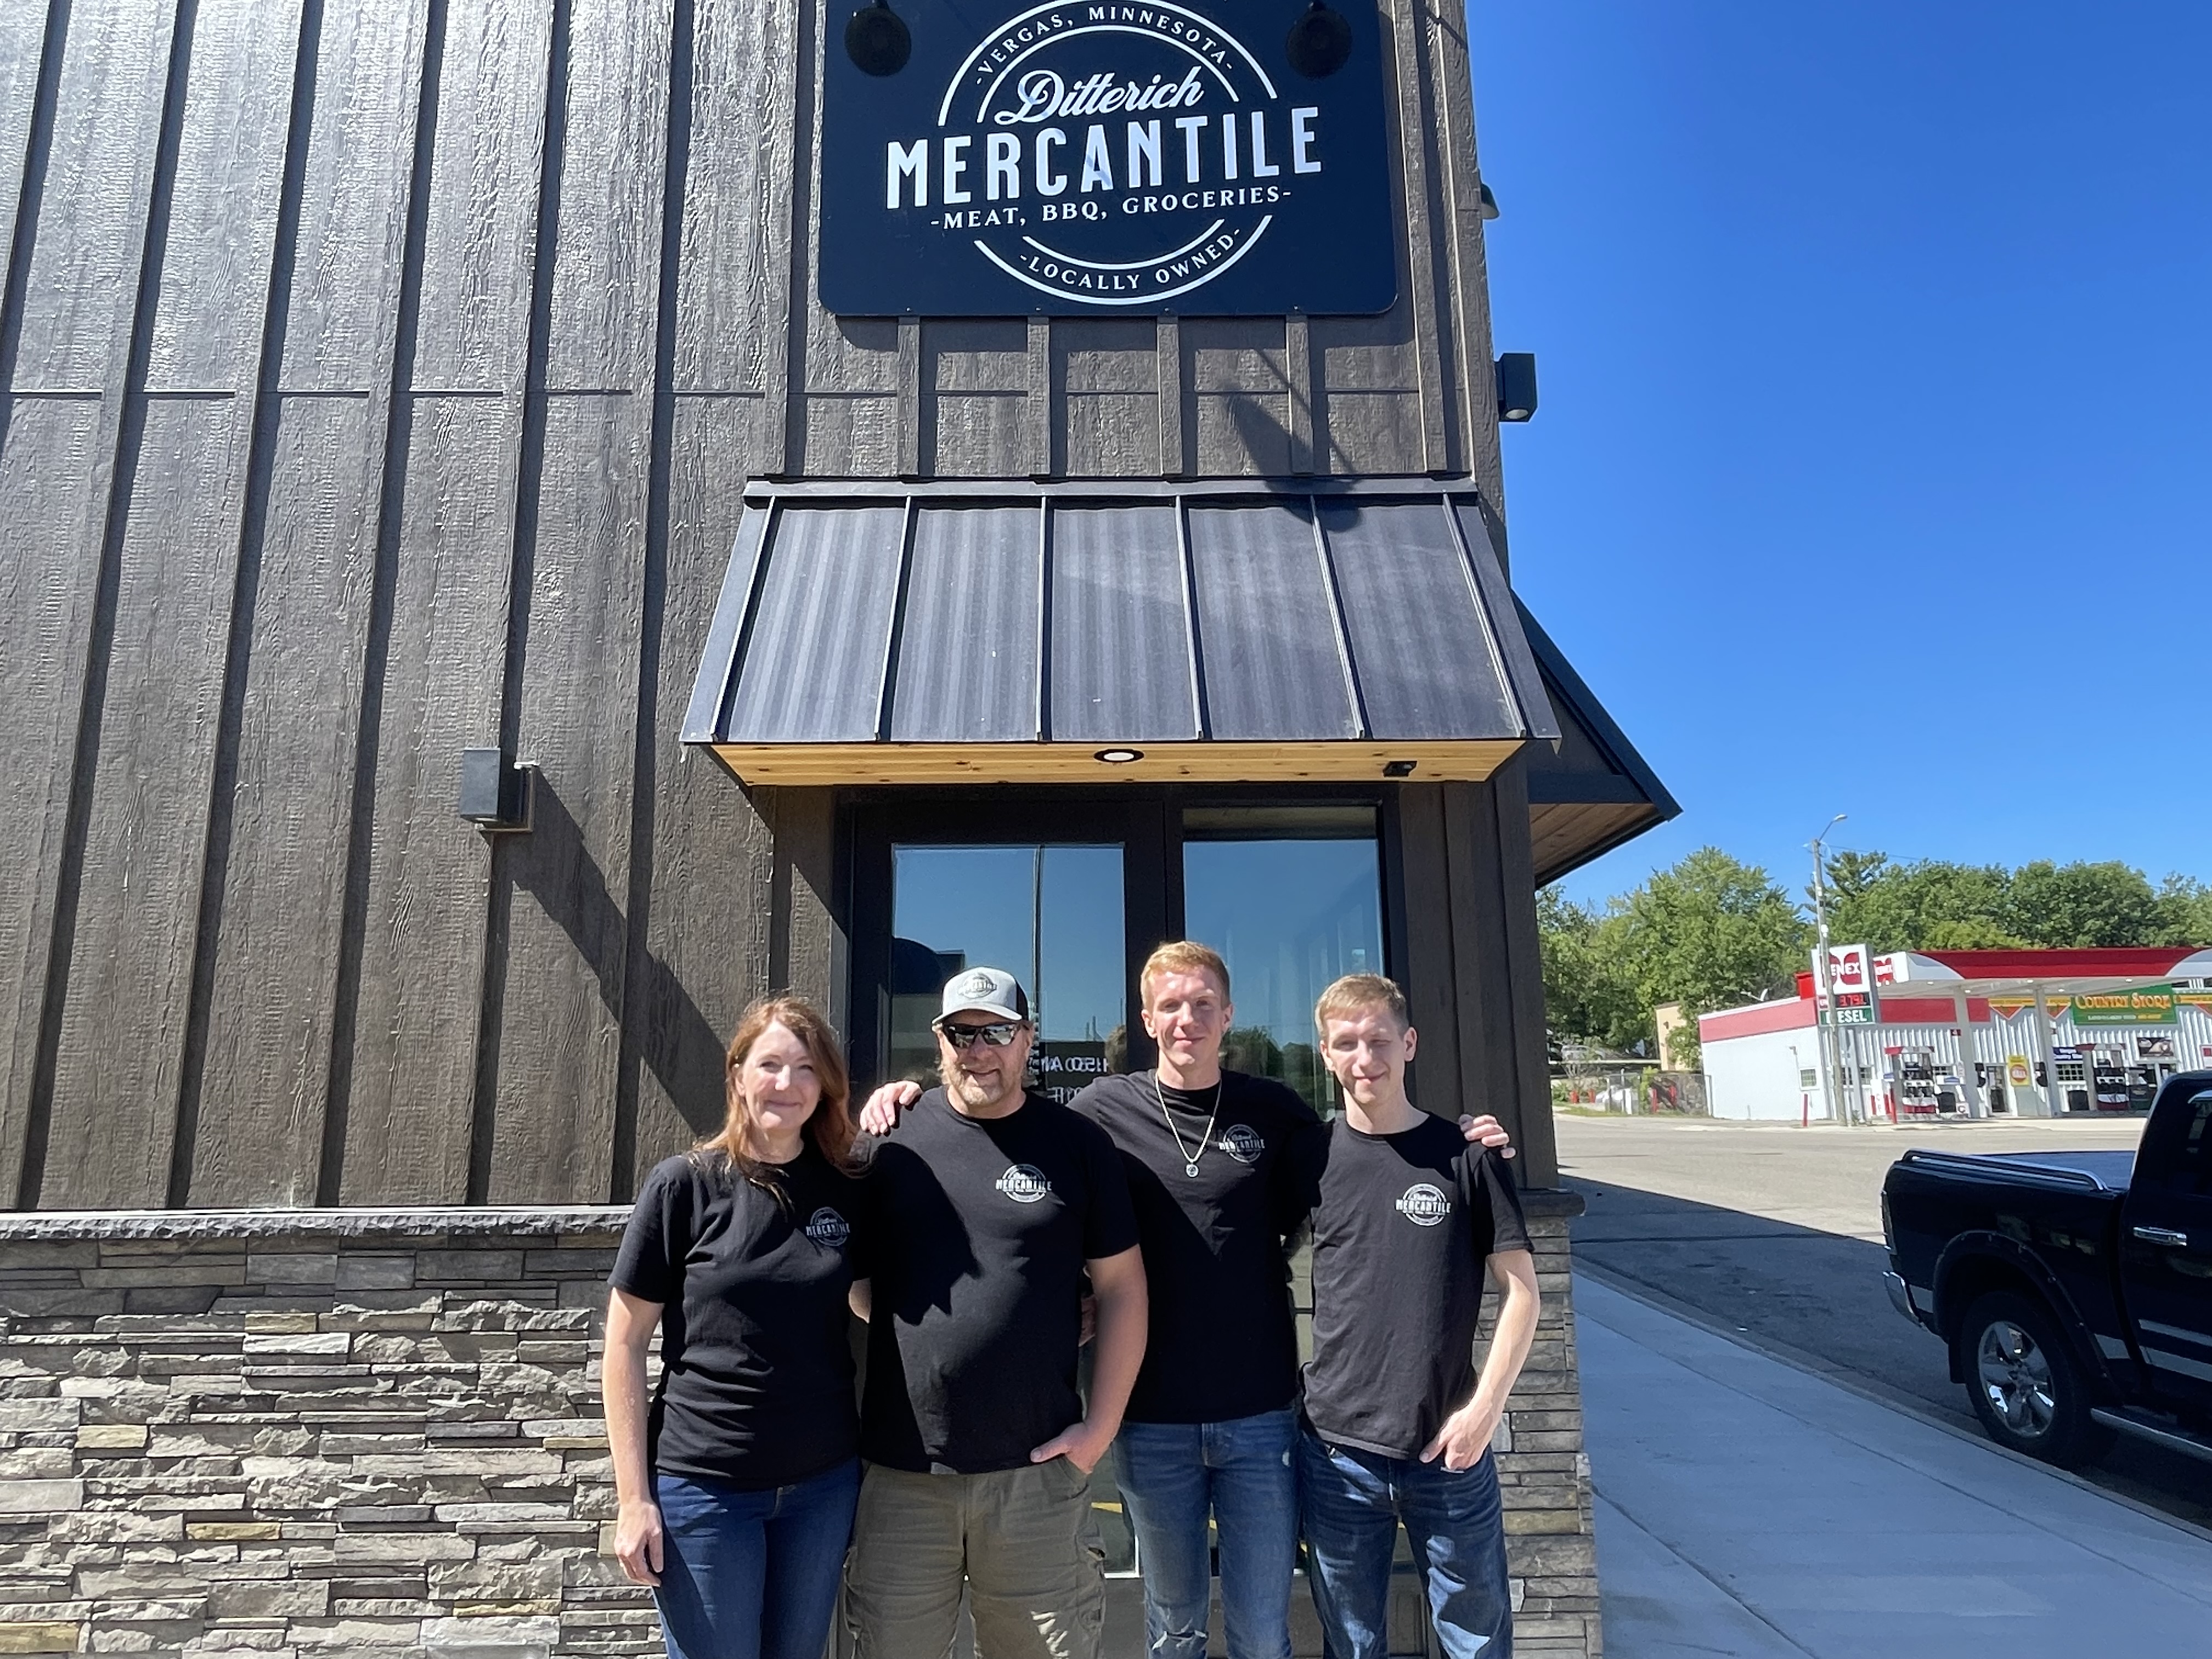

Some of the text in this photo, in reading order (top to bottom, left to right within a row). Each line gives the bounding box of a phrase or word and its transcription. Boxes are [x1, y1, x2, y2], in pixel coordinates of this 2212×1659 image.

[994, 66, 1205, 126] Ditterich
[887, 107, 1321, 209] MERCANTILE
[1042, 201, 1107, 222] BBQ,
[1822, 962, 1861, 977] ENEX
[1396, 1199, 1451, 1213] MERCANTILE
